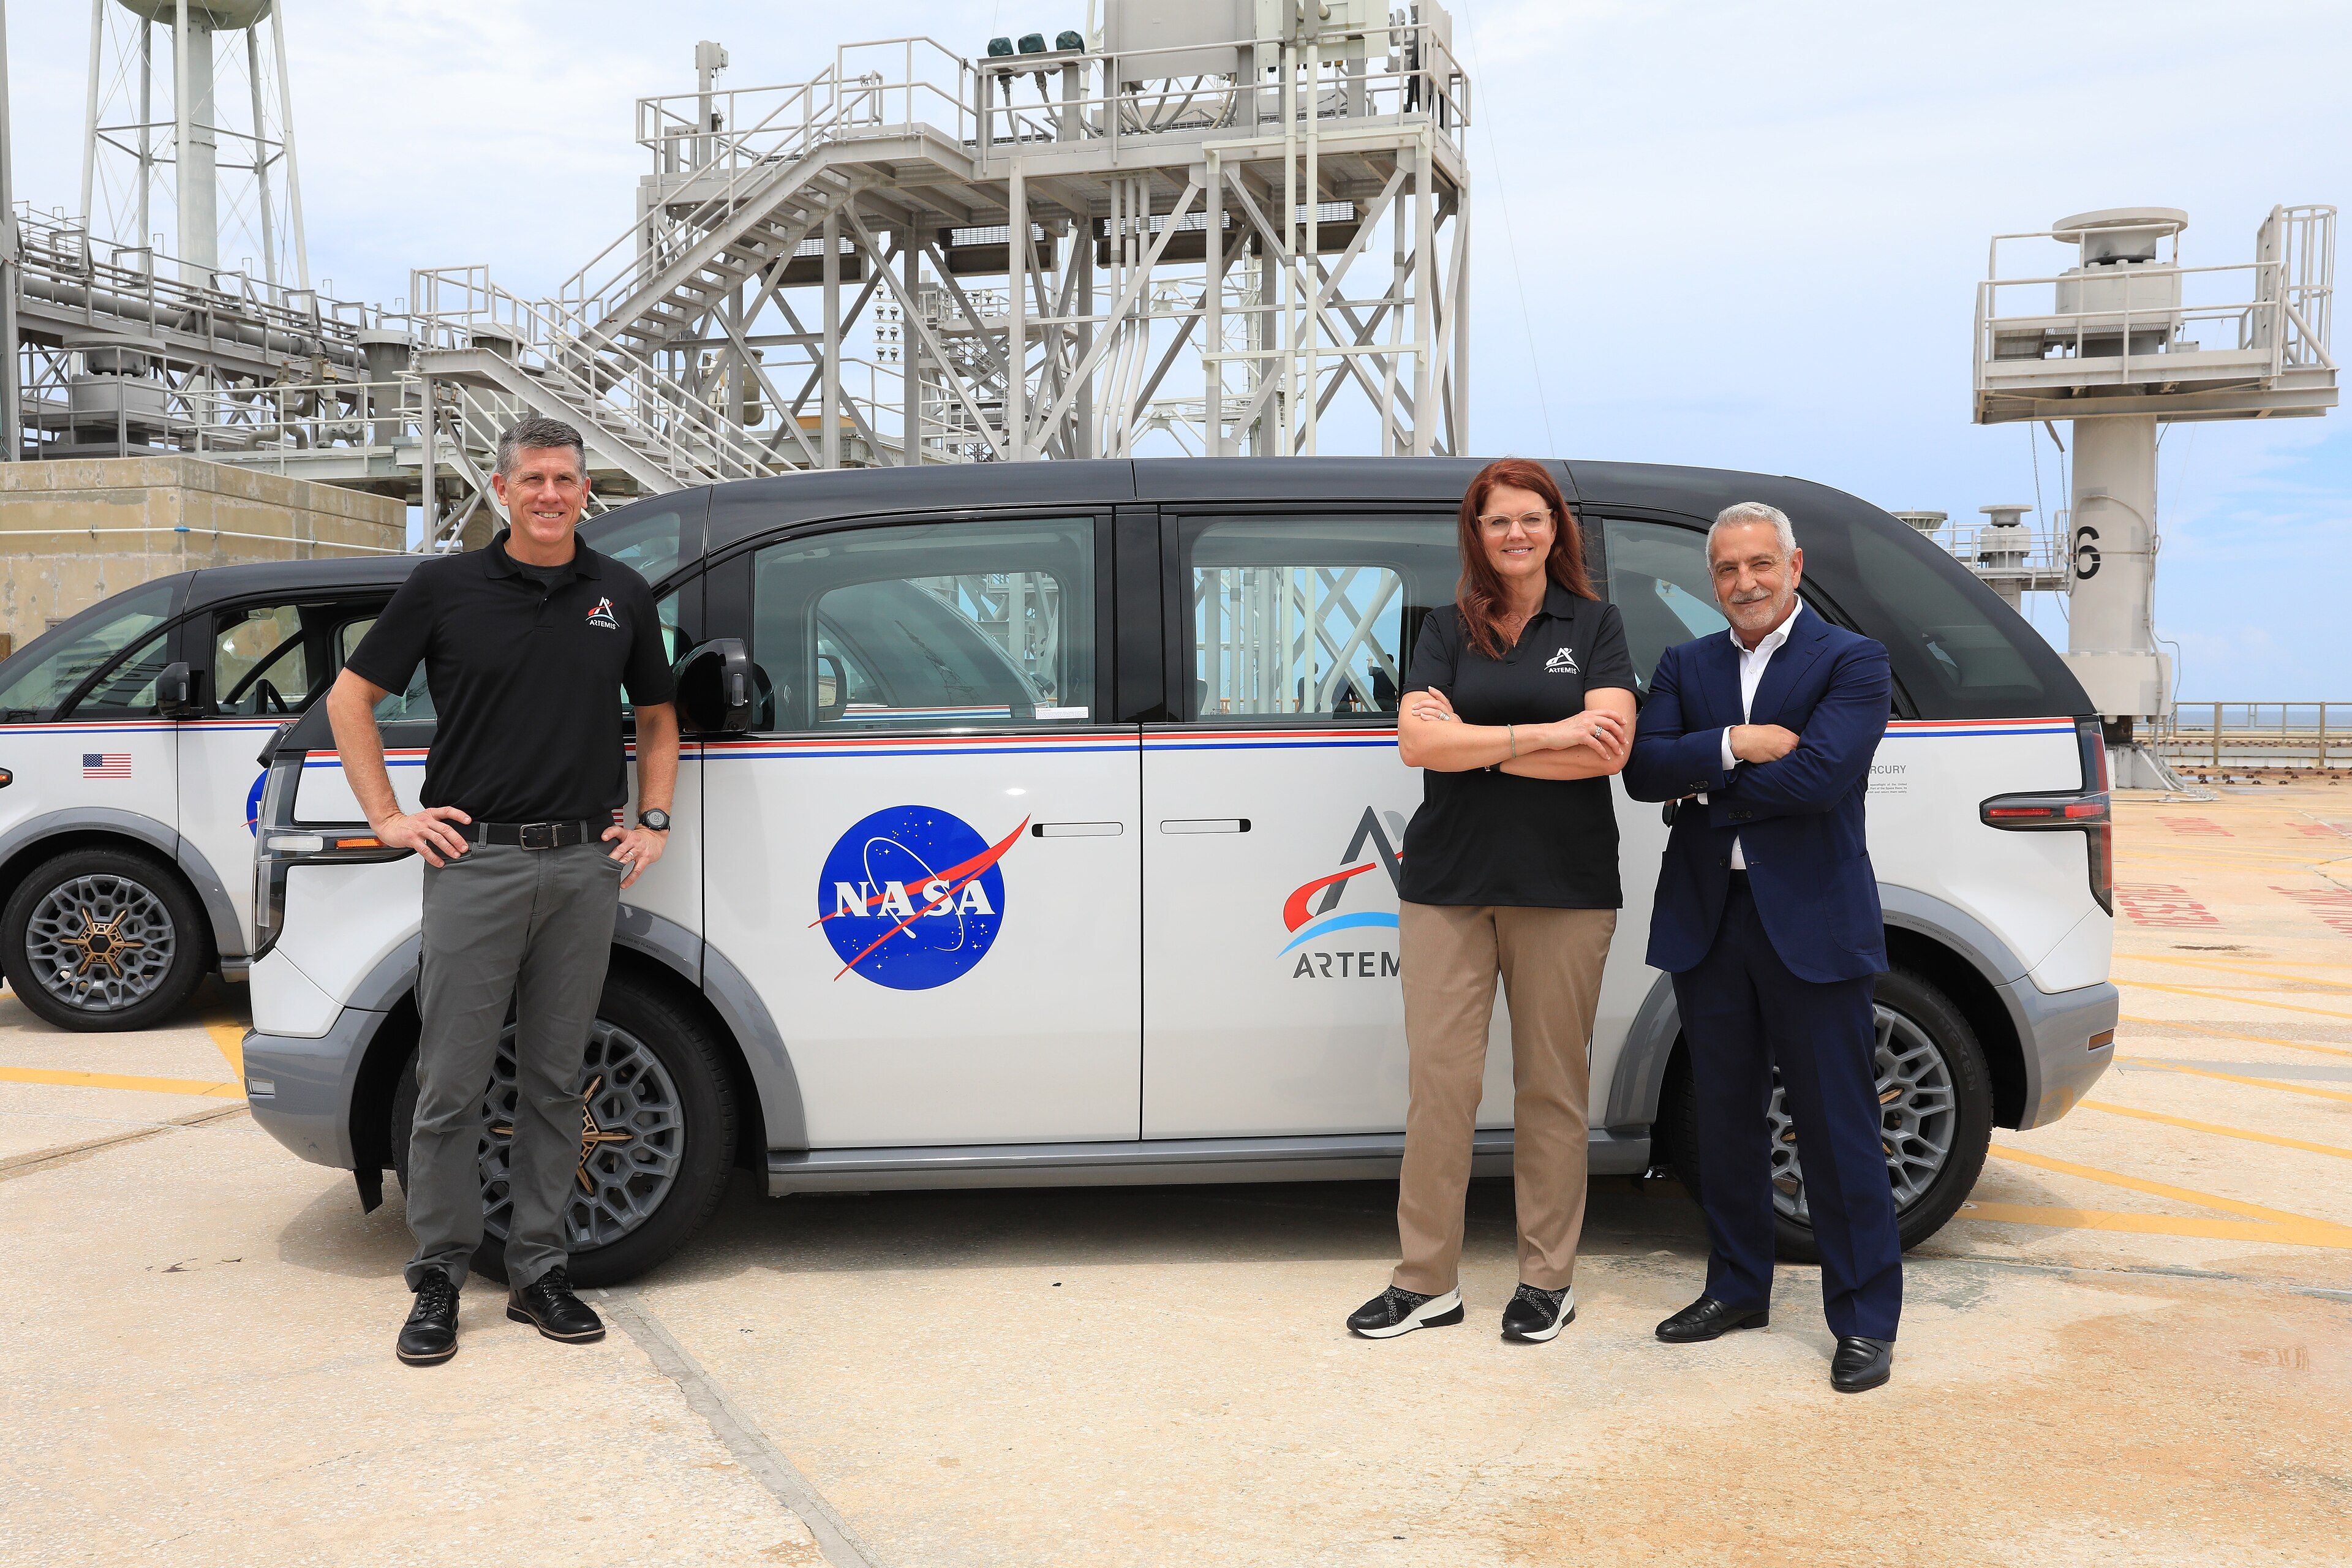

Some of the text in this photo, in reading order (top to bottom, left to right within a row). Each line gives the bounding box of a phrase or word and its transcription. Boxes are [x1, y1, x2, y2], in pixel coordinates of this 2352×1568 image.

[2073, 526, 2100, 579] 6
[589, 619, 616, 630] ARTEMIS
[1870, 765, 1907, 774] RCURY
[834, 878, 996, 918] NASA
[1293, 951, 1400, 978] ARTEM
